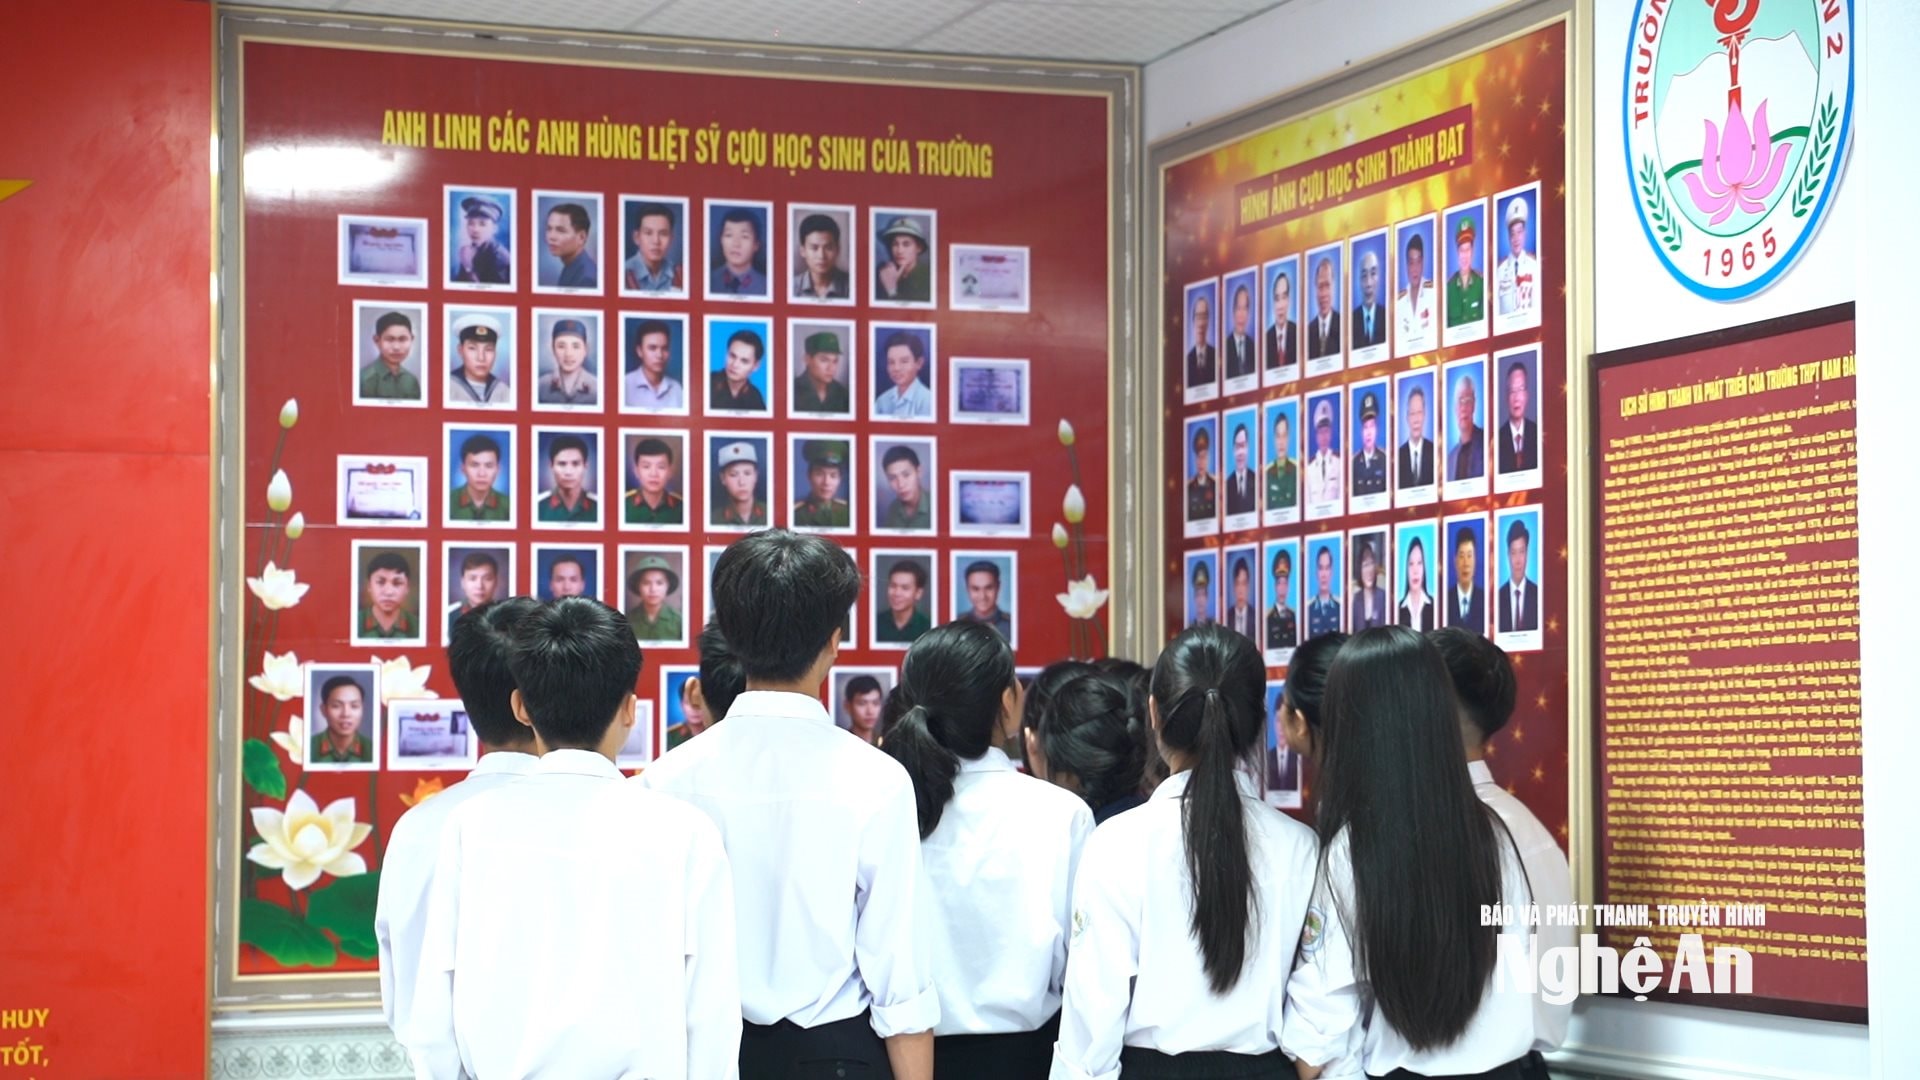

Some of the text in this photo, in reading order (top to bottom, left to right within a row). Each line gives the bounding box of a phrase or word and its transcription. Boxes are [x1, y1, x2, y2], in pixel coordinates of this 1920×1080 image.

[1827, 32, 1843, 59] 2
[382, 110, 993, 178] ANH LINH CÁC ANH HÙNG LIỆT SỸ CỰU HỌC SINH CỦA TRƯỜNG
[1240, 123, 1465, 226] HÌNH ẢNH CỰU HỌC SINH THÀNH ĐẠT
[1703, 227, 1777, 277] 1965
[1693, 379, 1703, 404] VÀ
[1704, 376, 1724, 402] PHÁT
[1748, 366, 1765, 394] CỦA
[1766, 363, 1798, 391] TRƯỜNG
[1799, 361, 1820, 385] THPT
[1822, 357, 1841, 381] NAM
[1842, 350, 1856, 377] ĐÀ
[2, 1008, 49, 1029] HUY
[0, 1037, 48, 1067] TỐT,
